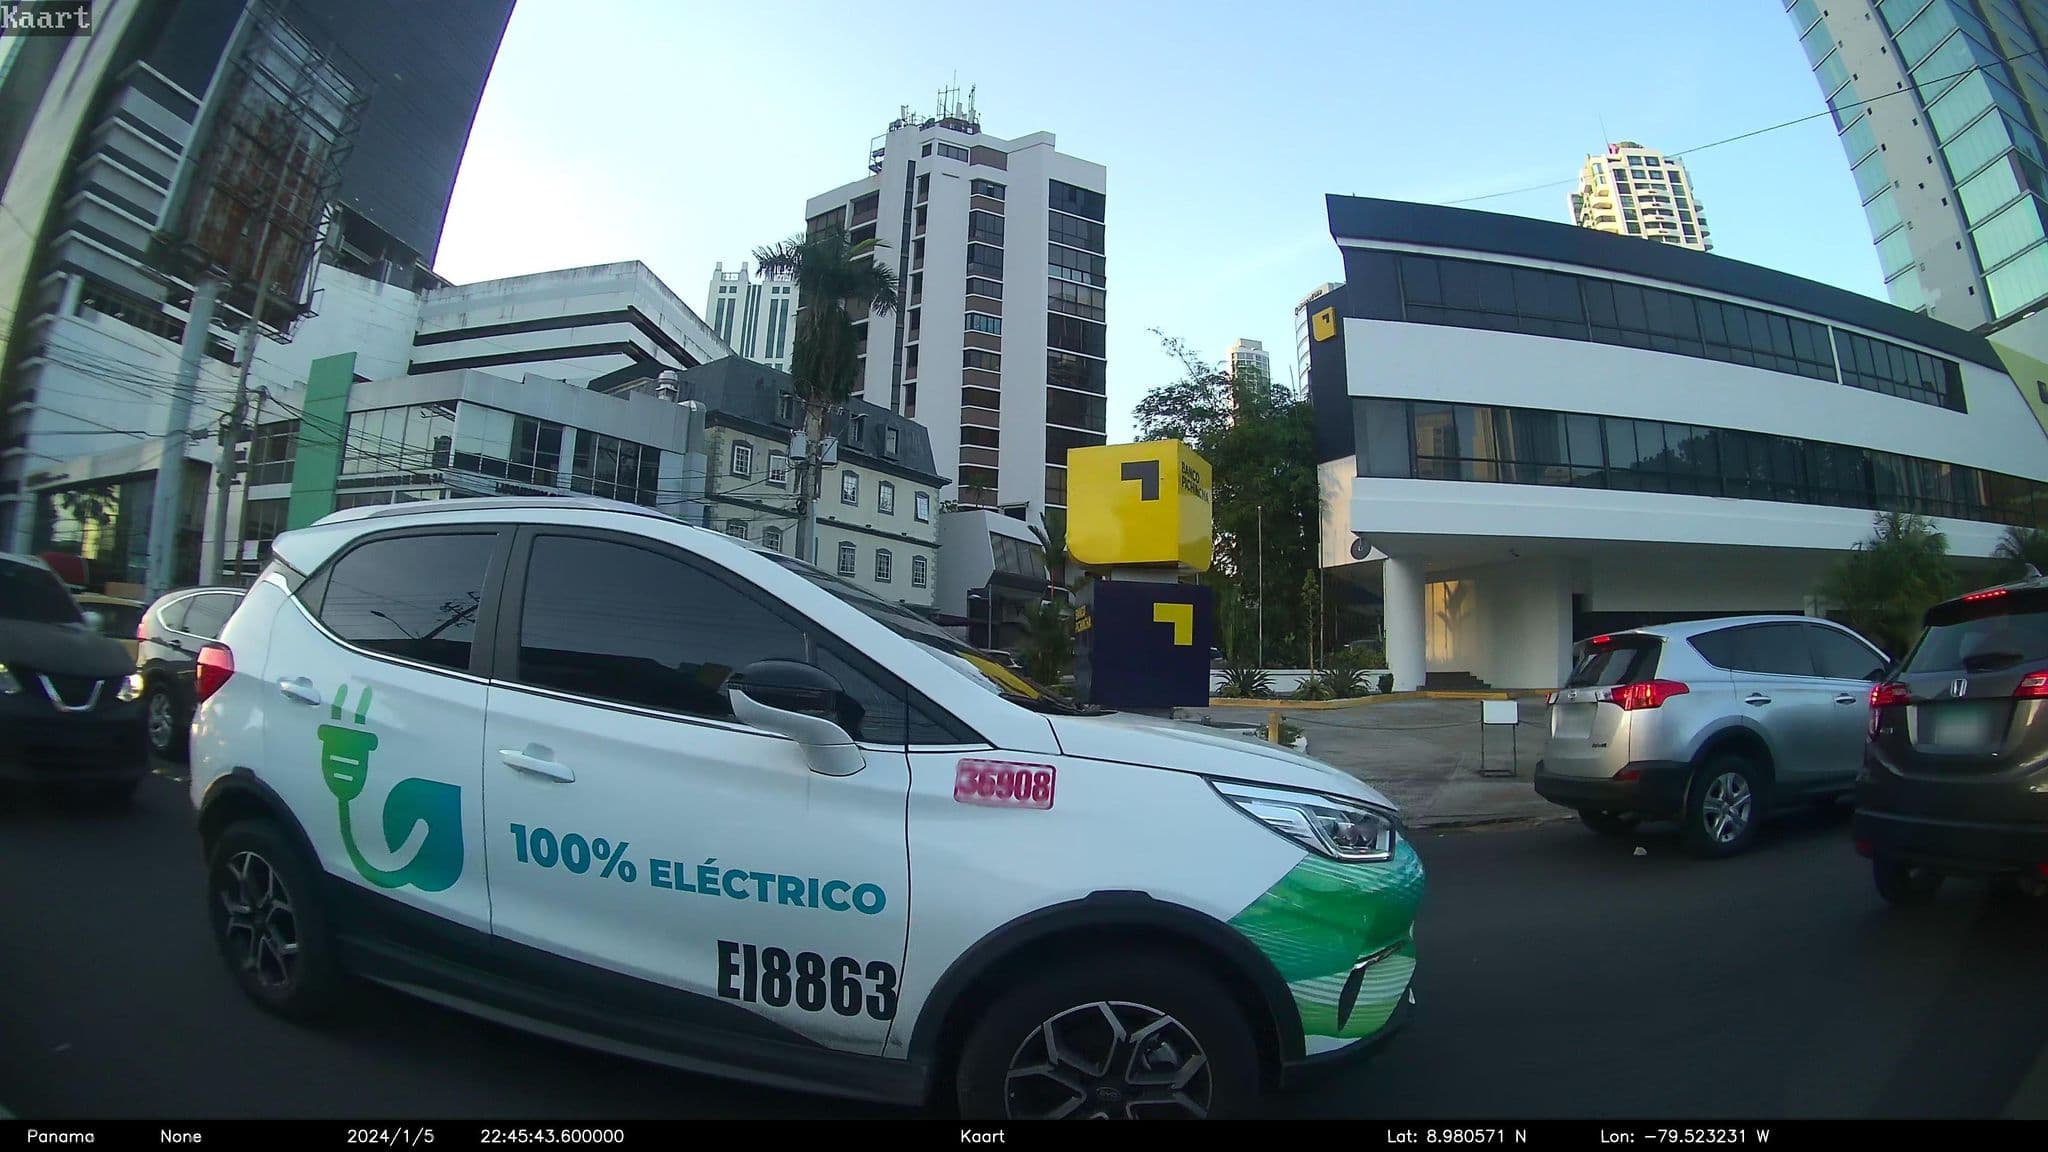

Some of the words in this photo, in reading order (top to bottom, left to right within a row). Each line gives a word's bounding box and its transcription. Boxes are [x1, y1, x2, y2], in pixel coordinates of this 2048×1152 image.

[1181, 461, 1200, 484] BANCO
[958, 766, 1051, 802] 36908
[510, 822, 637, 883] 100%
[649, 857, 887, 915] ELÉCTRICO
